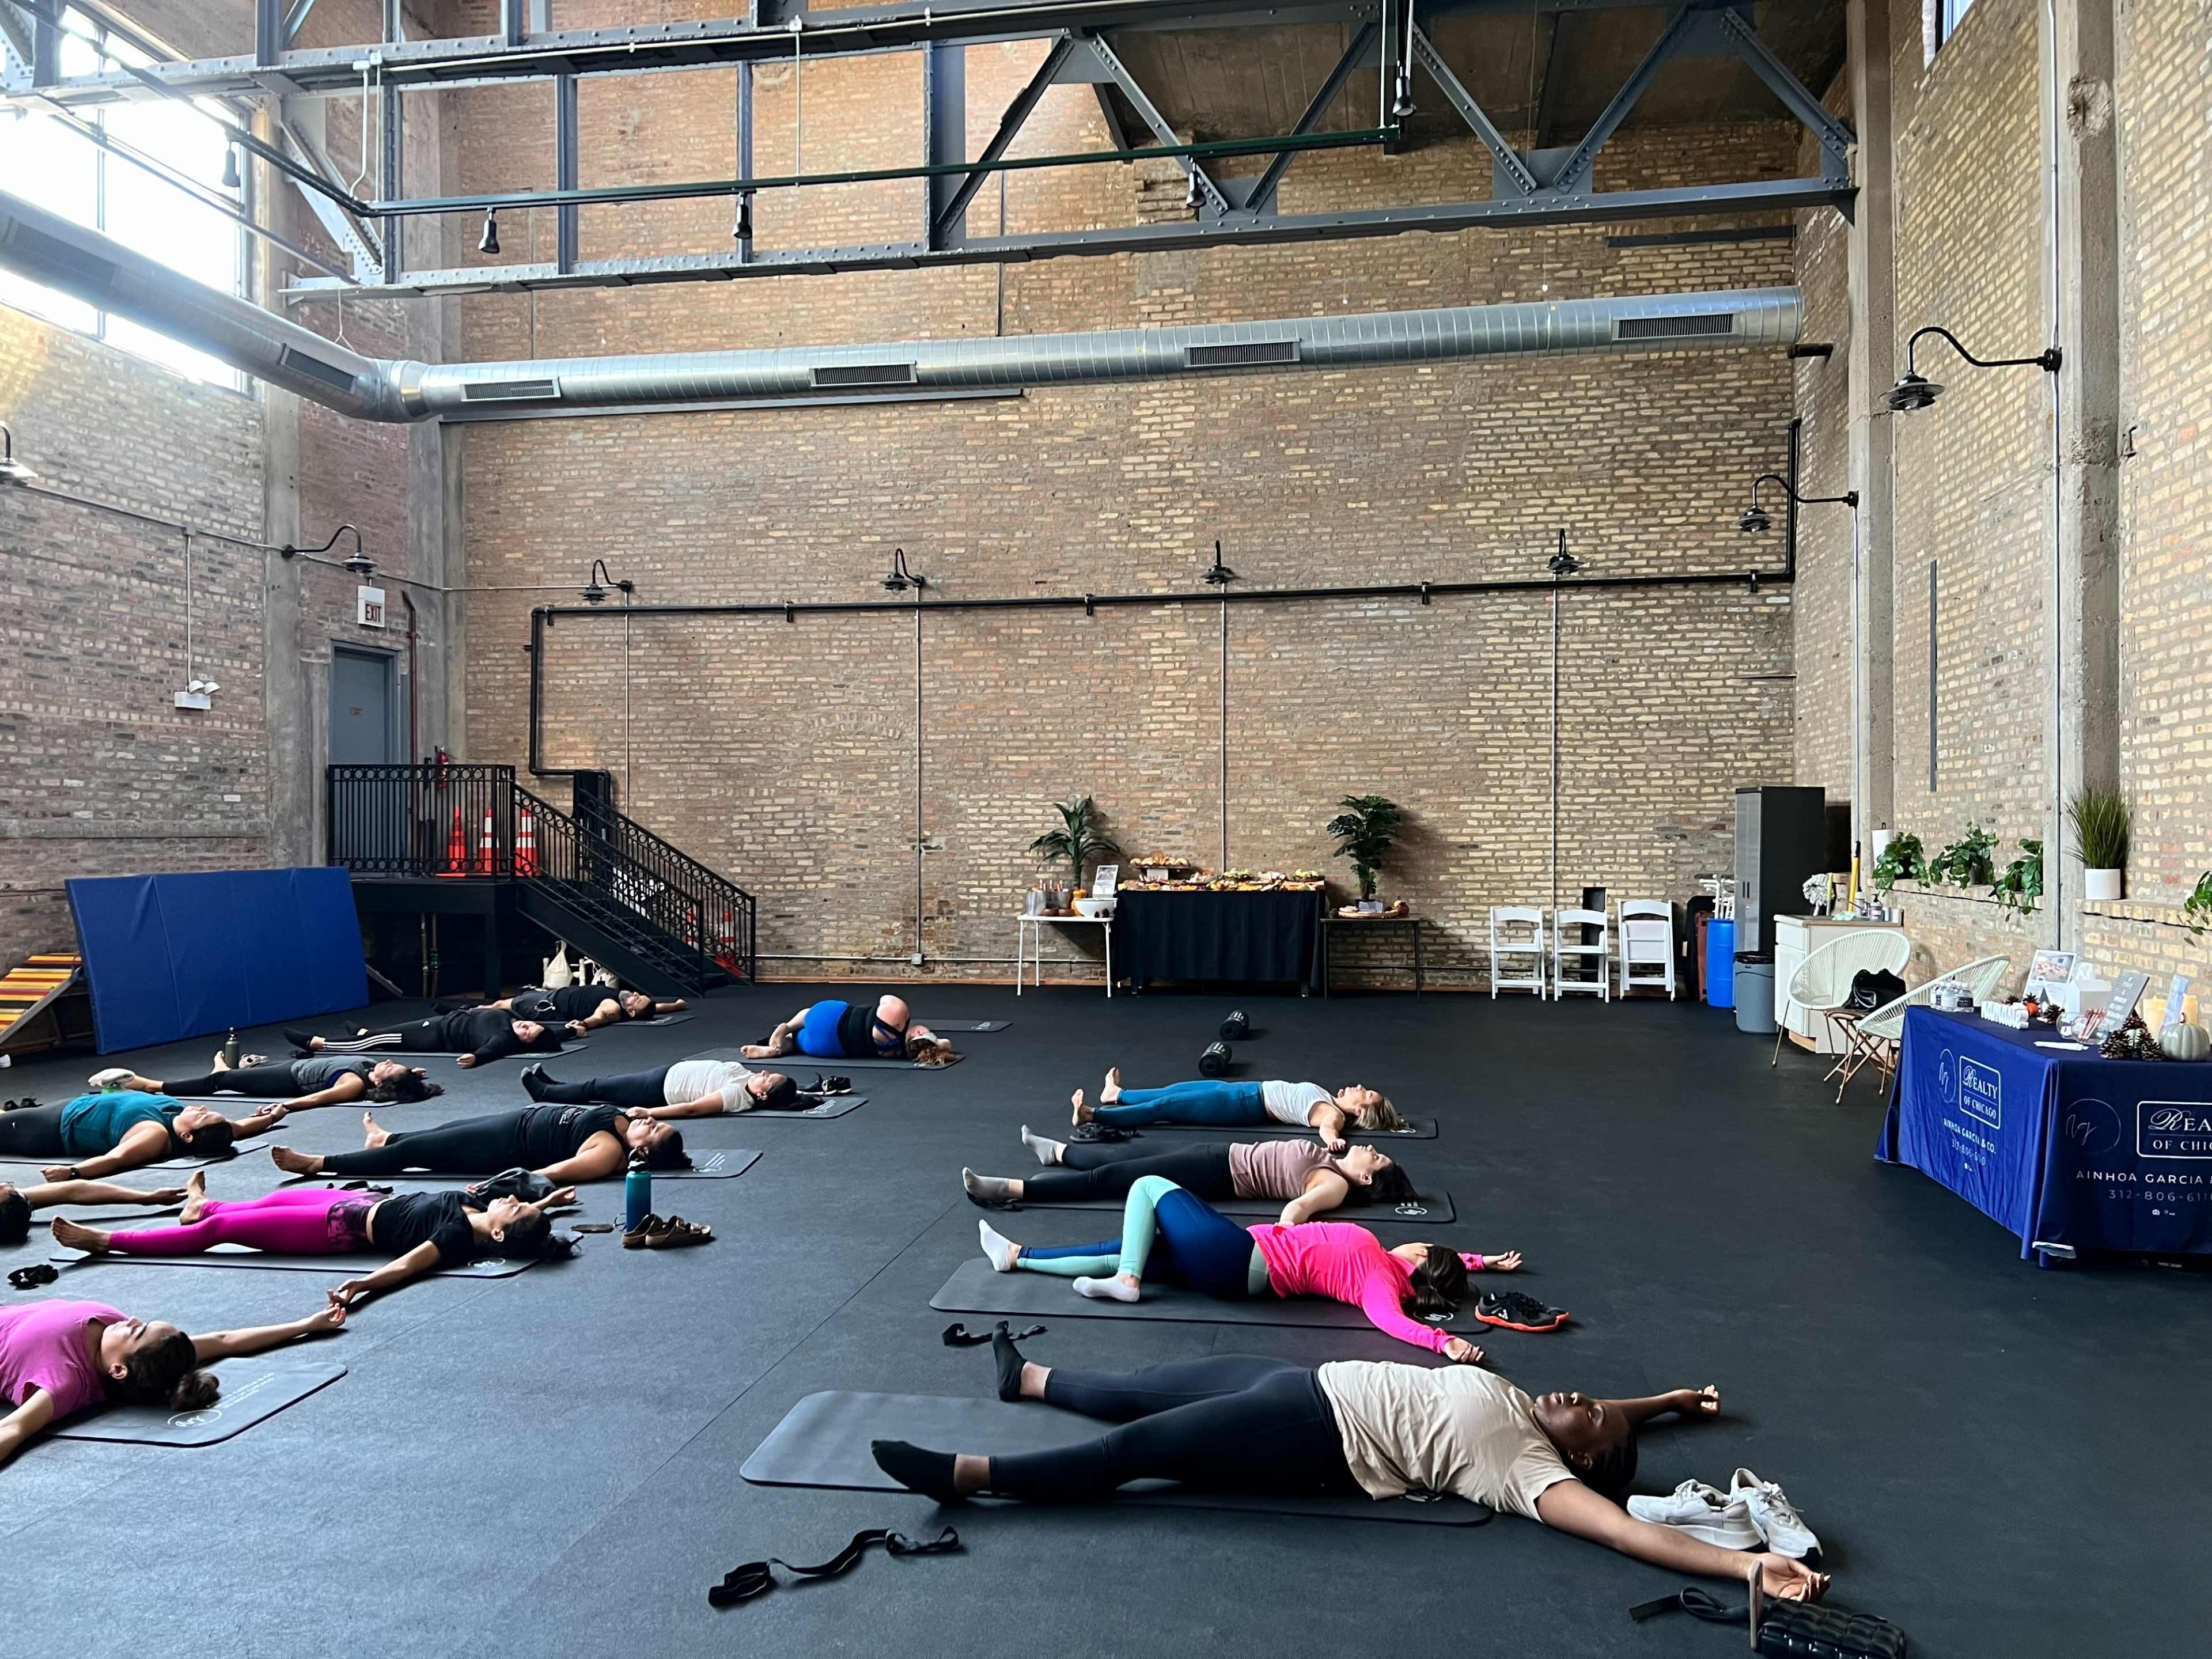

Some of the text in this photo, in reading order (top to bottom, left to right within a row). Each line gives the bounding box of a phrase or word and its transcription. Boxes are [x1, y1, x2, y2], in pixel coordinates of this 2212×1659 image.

[366, 603, 381, 623] EXIT
[1963, 1065, 1998, 1099] REALTY
[1964, 1096, 1997, 1119] OF CHICAGO
[1987, 1141, 1996, 1154] CO.
[2153, 1140, 2173, 1150] OF
[2076, 1171, 2137, 1181] AINHOA
[2145, 1174, 2203, 1184] GARCIA
[2108, 1190, 2212, 1202] 312-806-611
